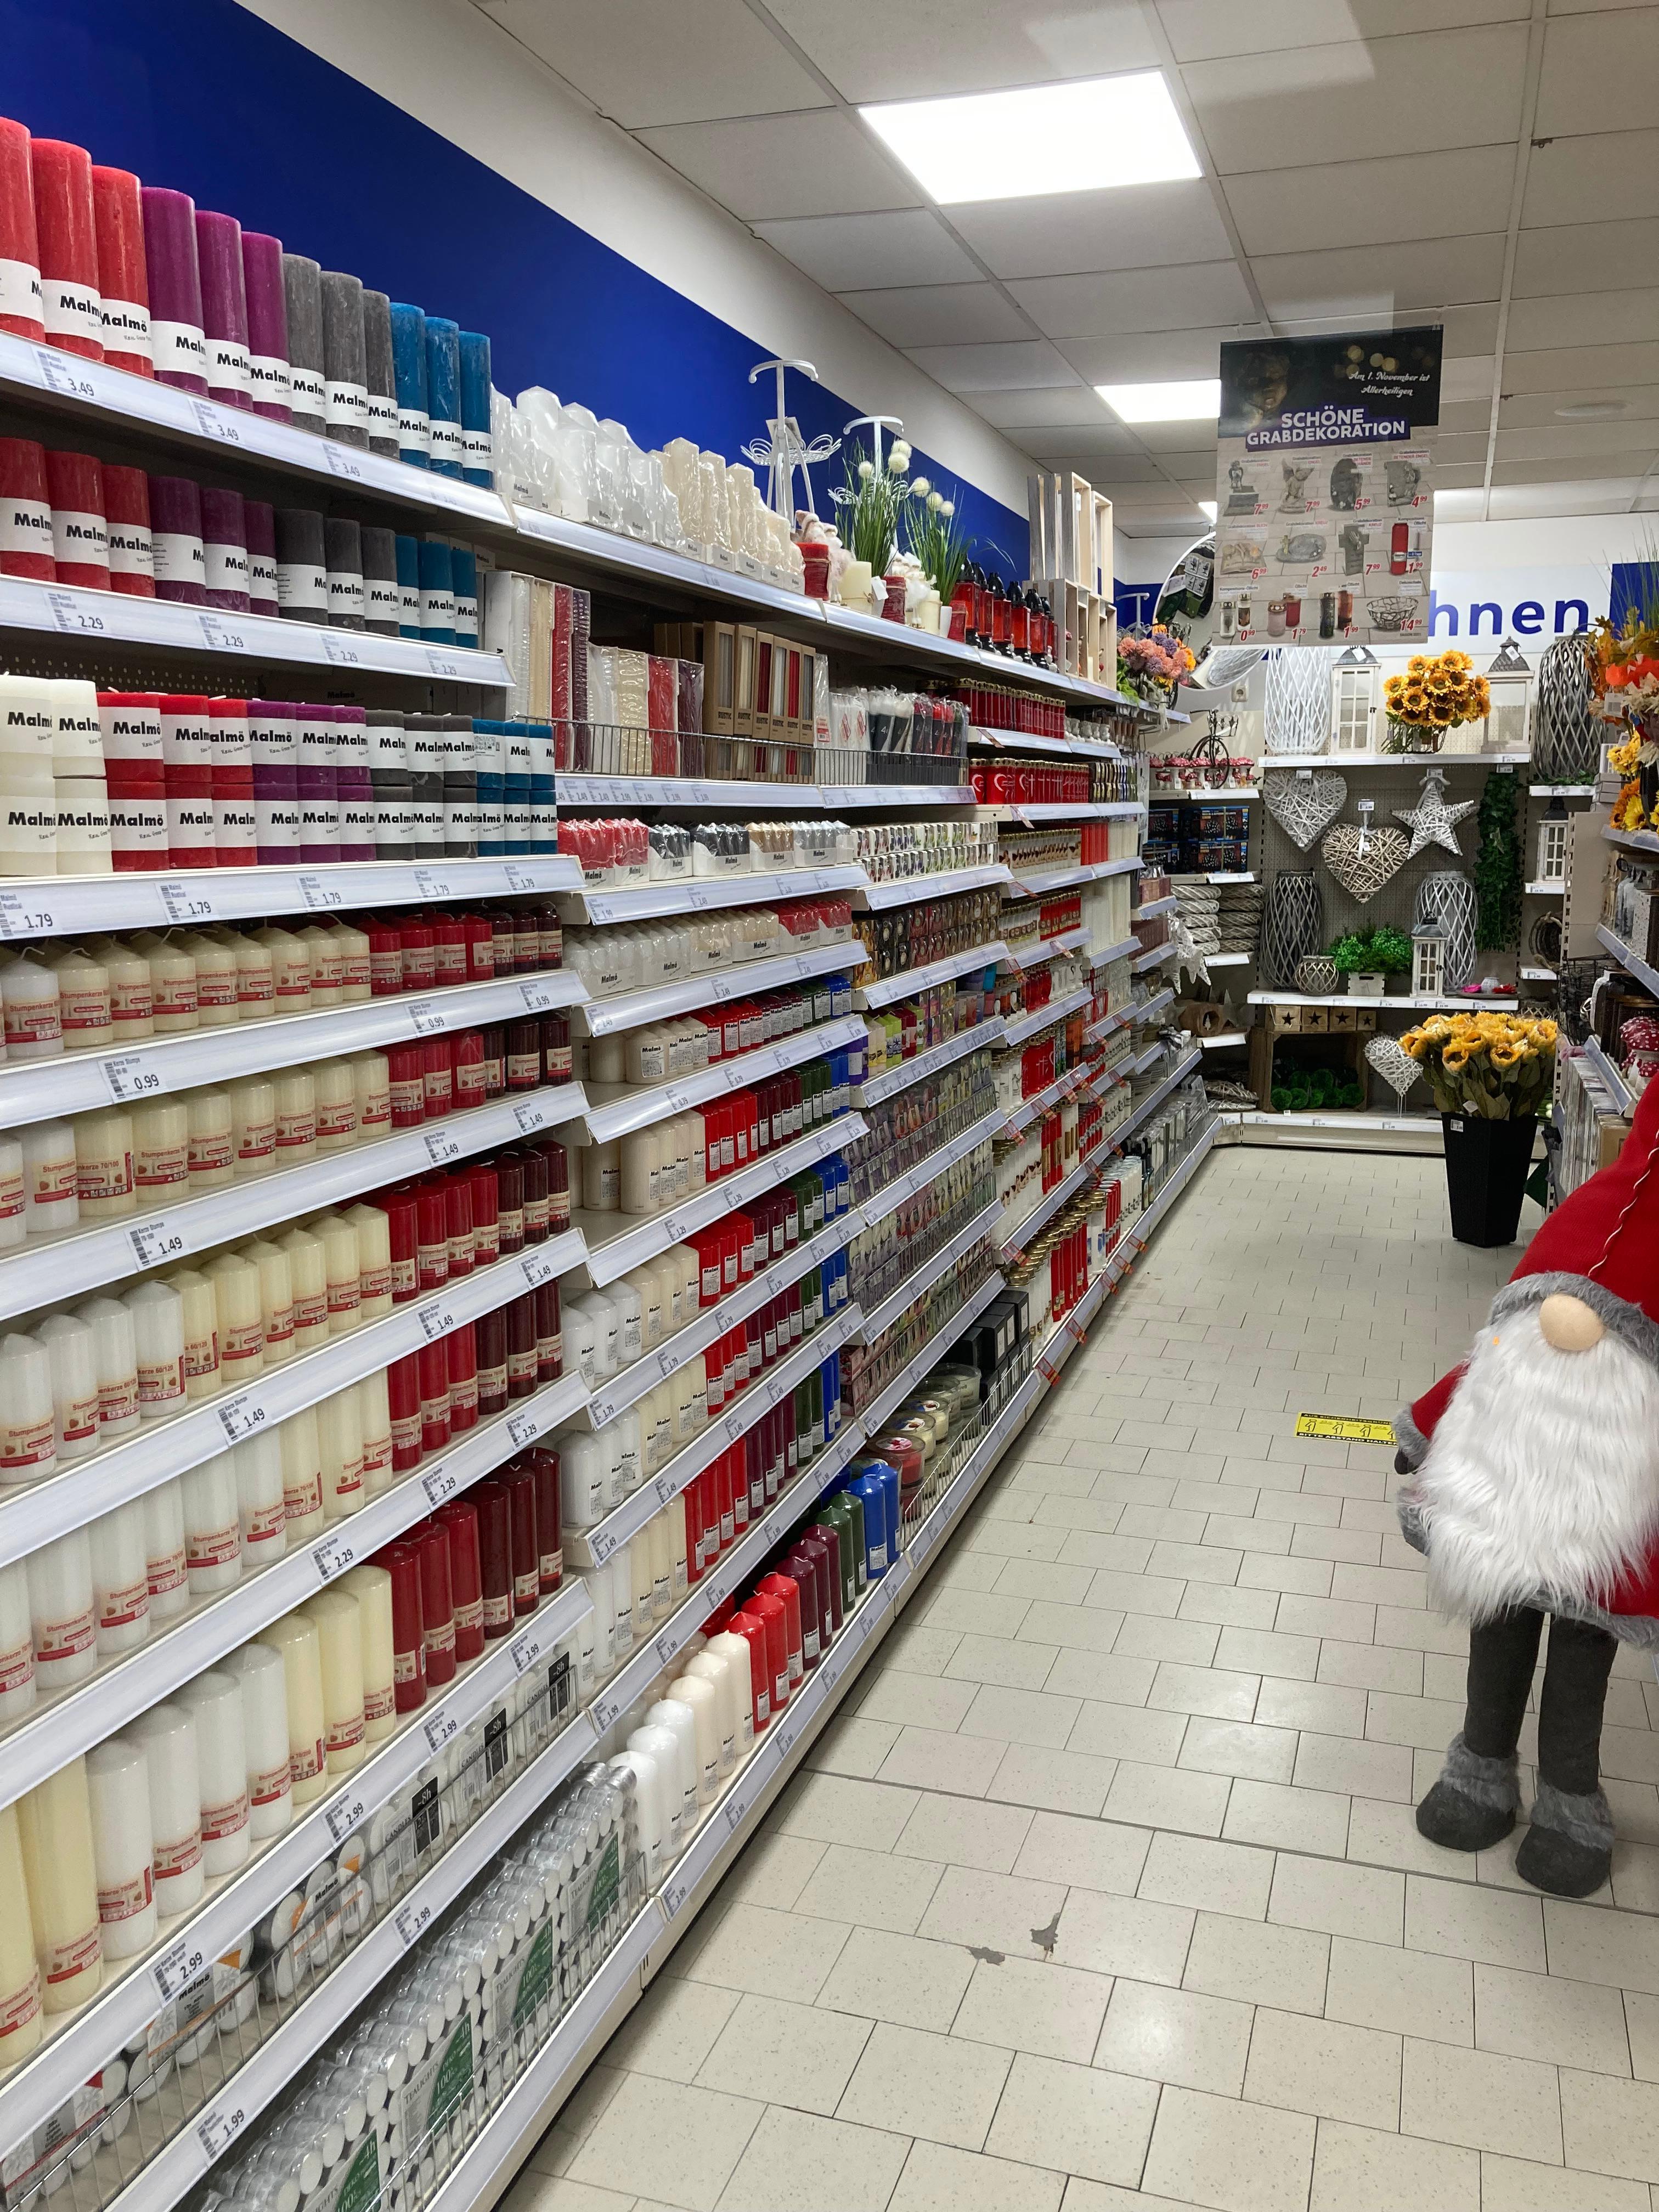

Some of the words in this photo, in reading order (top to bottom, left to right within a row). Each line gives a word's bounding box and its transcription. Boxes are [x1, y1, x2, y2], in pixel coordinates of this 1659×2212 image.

[1349, 371, 1364, 381] Am
[1376, 372, 1418, 382] November
[68, 377, 94, 397] 3.49
[1361, 385, 1413, 398] Allerheiligen
[1282, 405, 1364, 428] SCHÖNE
[218, 424, 239, 441] 3.49
[1247, 420, 1404, 445] GRABDEKORATION
[343, 462, 360, 477] 3.49
[1429, 589, 1589, 636] hnen
[78, 615, 104, 630] 2.29
[223, 635, 244, 648] 2.29
[341, 651, 358, 662] 2.29
[442, 666, 456, 675] 2.29
[210, 731, 244, 742] almö
[111, 813, 163, 826] Malmö
[477, 814, 500, 823] almö
[585, 871, 602, 880] Malmö
[434, 885, 450, 895] 1.79
[521, 878, 535, 888] 1.79
[323, 893, 341, 904] 1.79
[189, 902, 212, 915] 1.79
[24, 913, 53, 929] 1.79
[601, 974, 618, 984] Malmö
[60, 989, 103, 999] Stumpenkerze
[537, 995, 550, 1006] 0.99
[10, 1003, 53, 1012] Stumpenkerze
[428, 1017, 444, 1028] 0.99
[134, 1074, 159, 1090] 0.99
[529, 1113, 543, 1126] 1.49
[443, 1143, 459, 1156] 1.49
[676, 1225, 686, 1237] 1.29
[159, 1237, 182, 1254] 1.49
[537, 1265, 551, 1278] 1.49
[438, 1315, 454, 1329] 1.49
[668, 1357, 679, 1369] 1.79
[244, 1408, 265, 1427] 1.49
[602, 1404, 614, 1418] 1.79
[523, 1424, 537, 1437] 2.29
[441, 1477, 456, 1494] 2.29
[667, 1483, 676, 1497] 1.49
[606, 1536, 617, 1550] 1.49
[335, 1549, 353, 1567] 2.29
[526, 1644, 539, 1660] 2.99
[667, 1640, 678, 1656] 1.99
[607, 1705, 619, 1721] 1.99
[442, 1720, 457, 1739] 2.99
[346, 1803, 364, 1825] 2.99
[315, 1877, 338, 1903] Malmö
[675, 1887, 687, 1904] 2.99
[414, 1907, 430, 1928] 2.99
[180, 1951, 202, 1980] 2.99
[223, 2109, 245, 2137] 1.99
